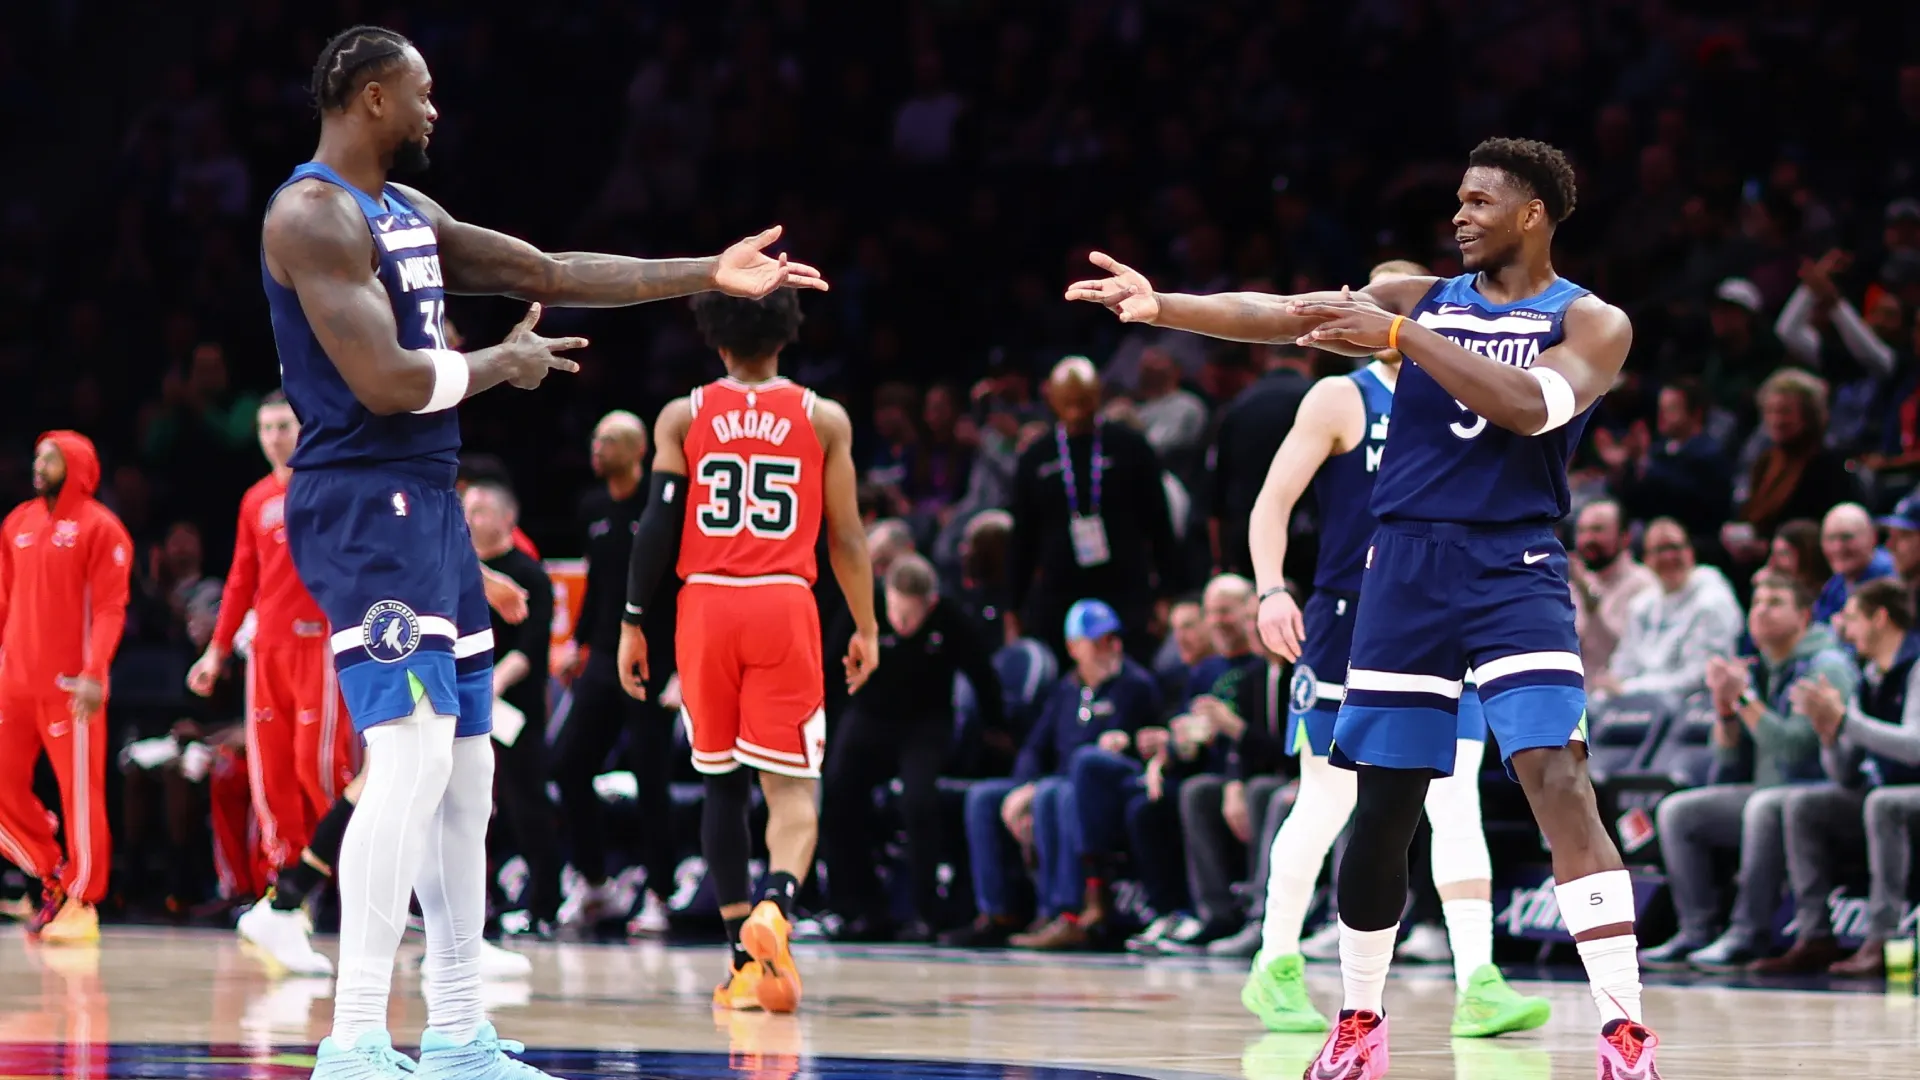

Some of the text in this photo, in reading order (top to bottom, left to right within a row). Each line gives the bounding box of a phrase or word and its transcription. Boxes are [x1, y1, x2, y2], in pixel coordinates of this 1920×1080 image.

[711, 409, 792, 446] OKORO
[696, 452, 801, 540] 35
[1589, 892, 1604, 906] 5
